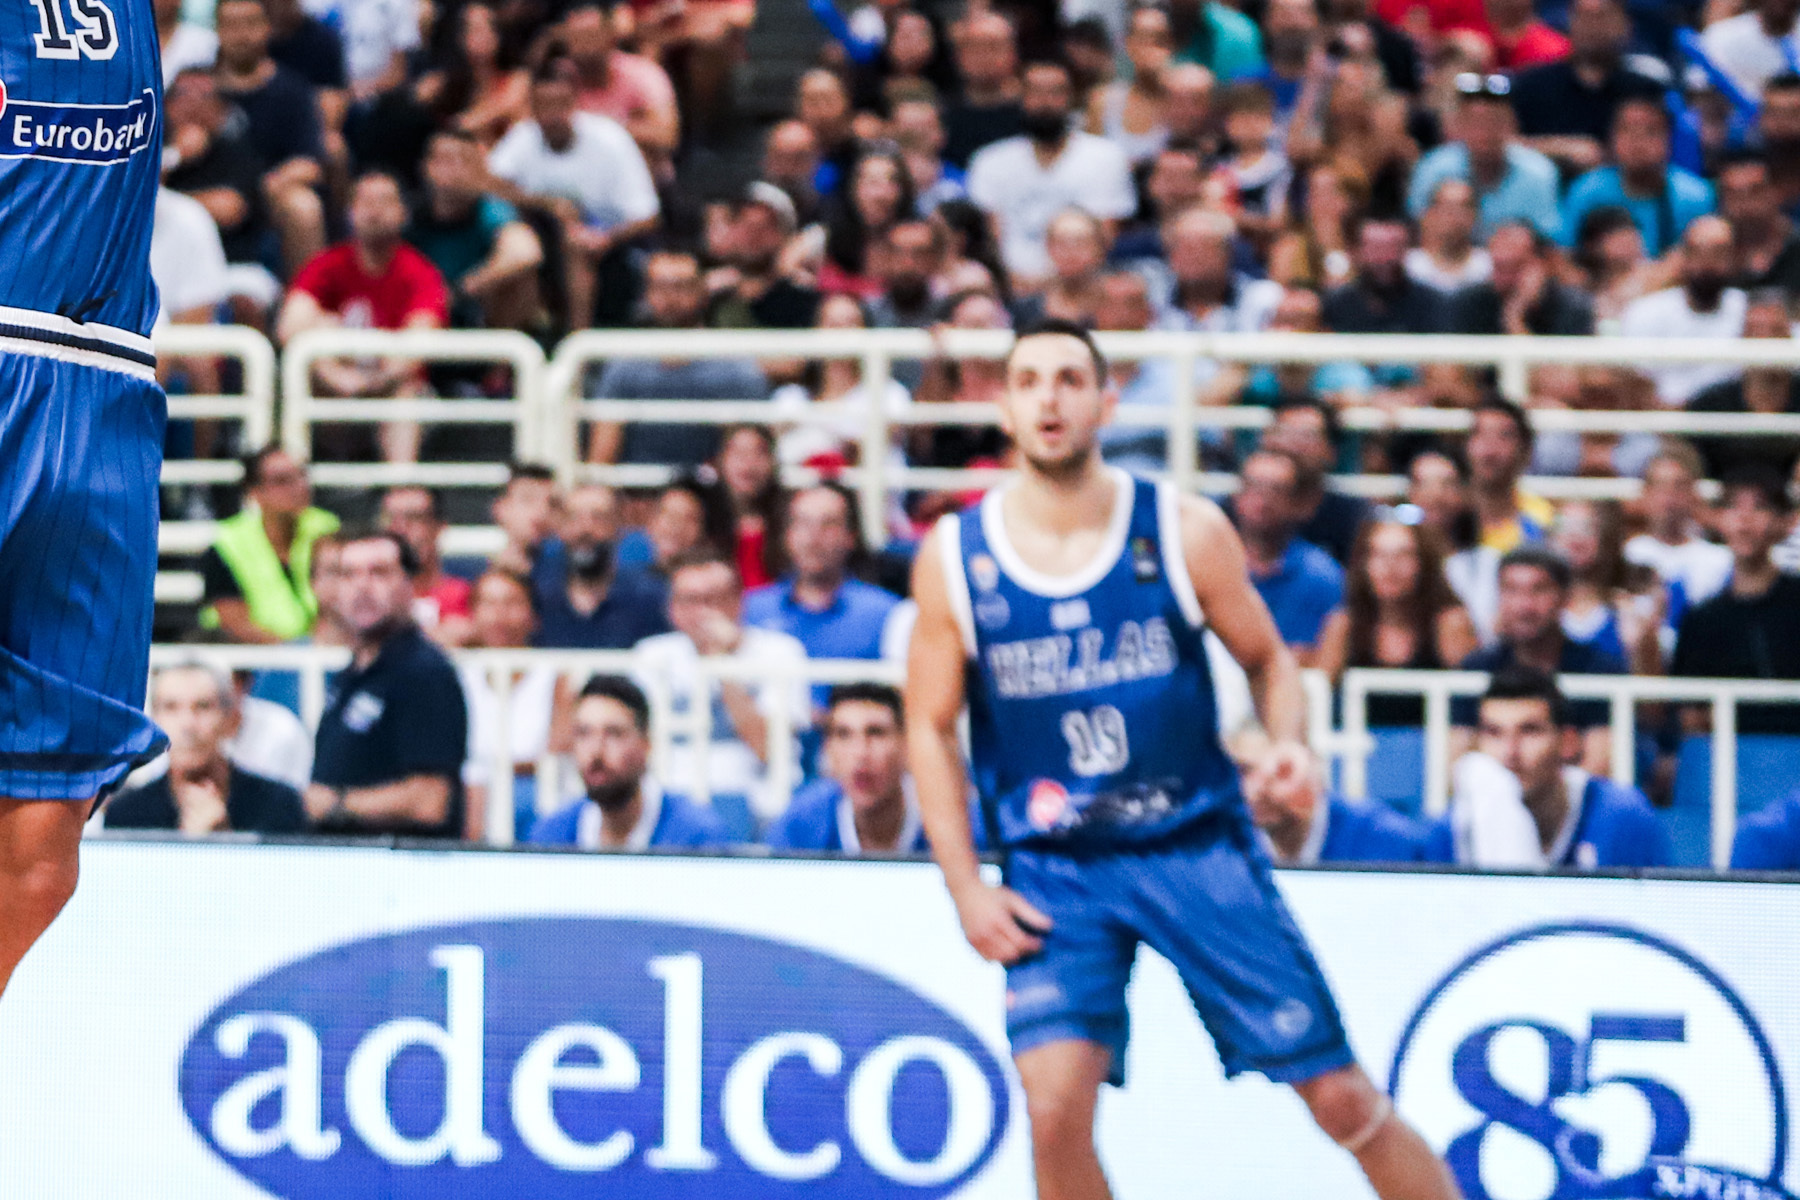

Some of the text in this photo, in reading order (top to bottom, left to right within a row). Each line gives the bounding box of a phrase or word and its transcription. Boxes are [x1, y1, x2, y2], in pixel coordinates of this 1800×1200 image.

[12, 112, 147, 152] Eurobank
[987, 616, 1178, 700] HELLAS
[210, 944, 996, 1185] adelco
[1446, 1012, 1692, 1200] 85
